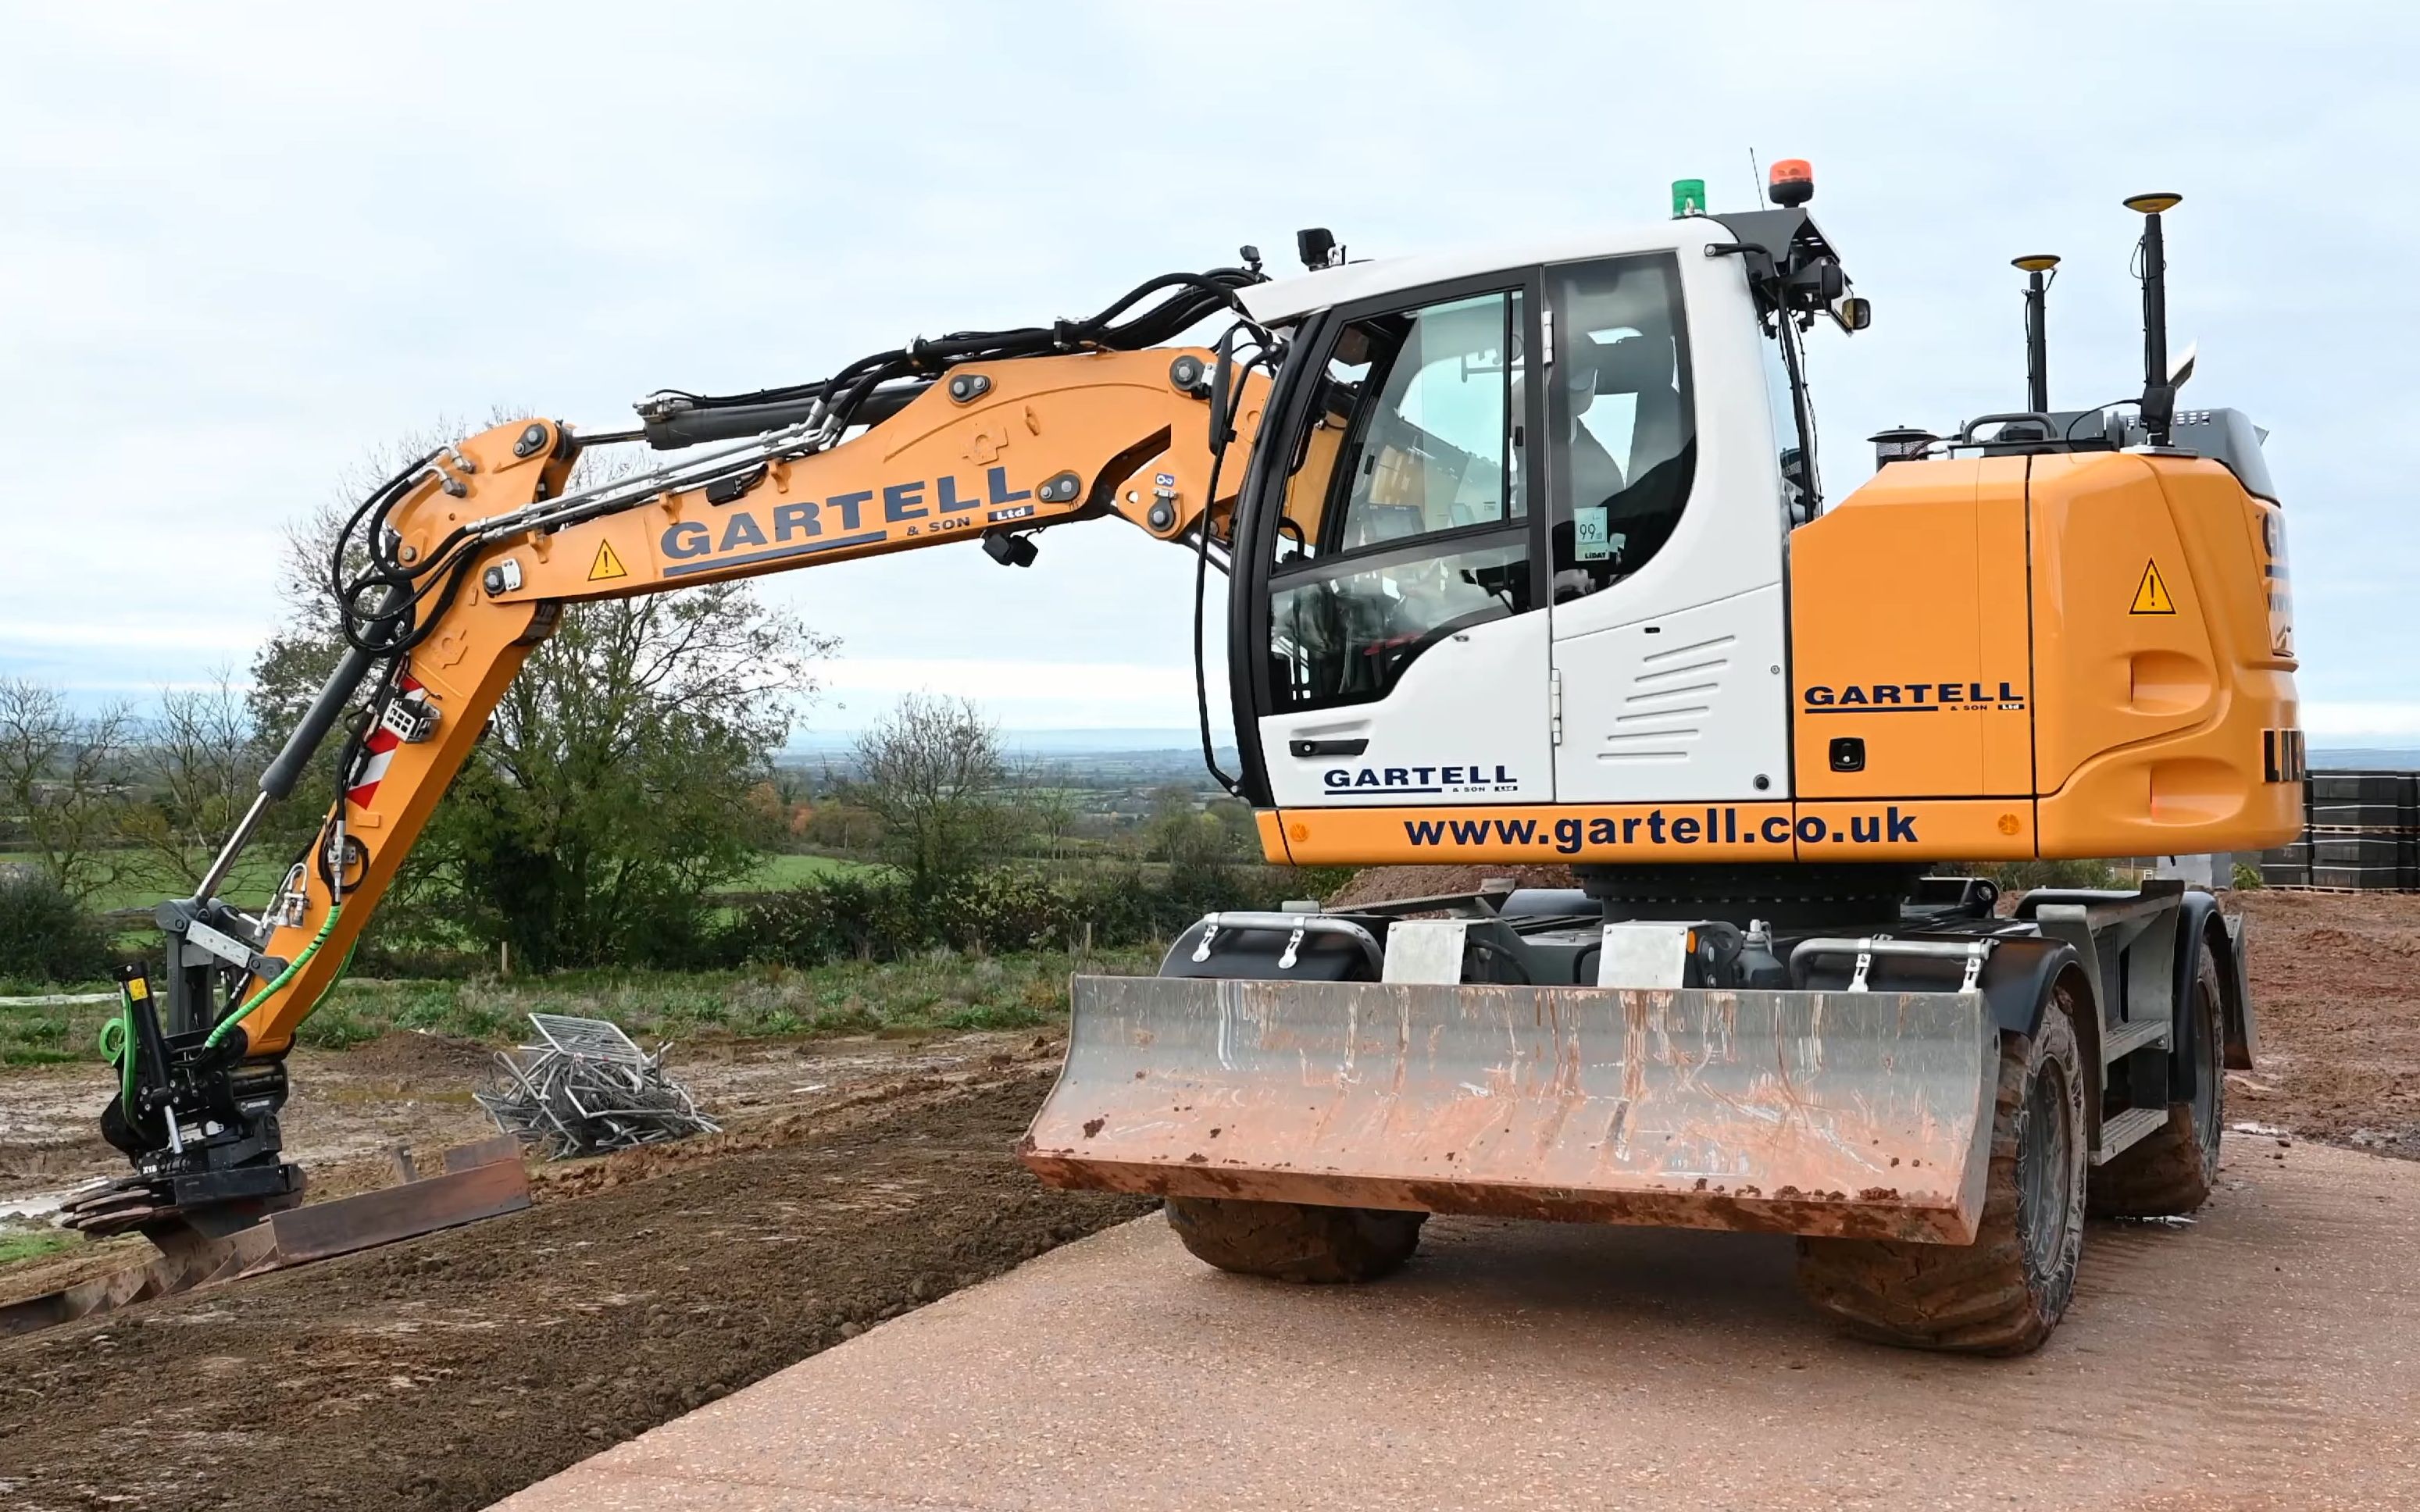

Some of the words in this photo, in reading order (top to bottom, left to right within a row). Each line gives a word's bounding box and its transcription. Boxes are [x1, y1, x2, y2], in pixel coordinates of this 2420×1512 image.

[661, 466, 1031, 560] GARTELL
[906, 526, 919, 537] &
[928, 516, 970, 533] SON
[996, 507, 1026, 521] Ltd
[1579, 523, 1597, 540] 99
[1804, 682, 2024, 705] GARTELL
[1323, 765, 1517, 787] GARTELL
[1404, 807, 1918, 854] www.gartell.co.uk
